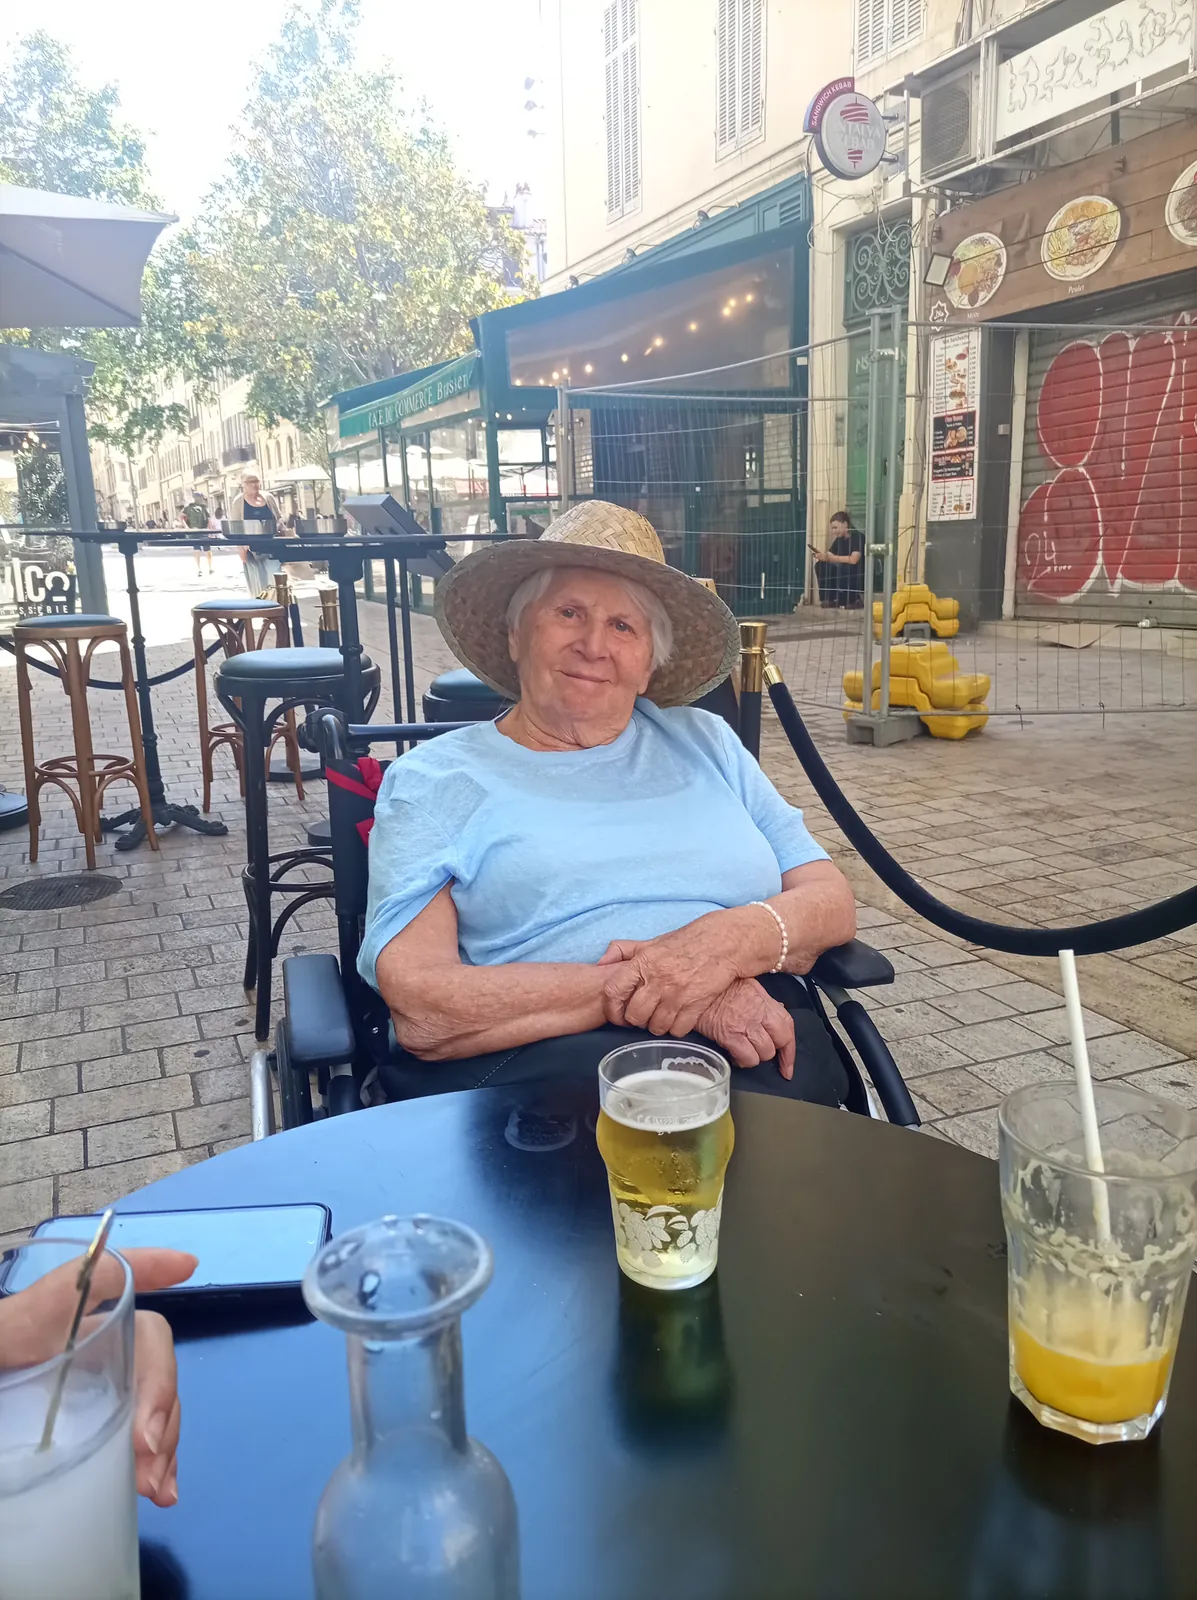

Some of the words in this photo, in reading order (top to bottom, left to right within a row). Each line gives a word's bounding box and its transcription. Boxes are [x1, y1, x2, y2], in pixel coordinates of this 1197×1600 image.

[811, 90, 833, 127] SANDWICH
[831, 81, 852, 93] KEBAB
[394, 387, 433, 418] COMMERCE
